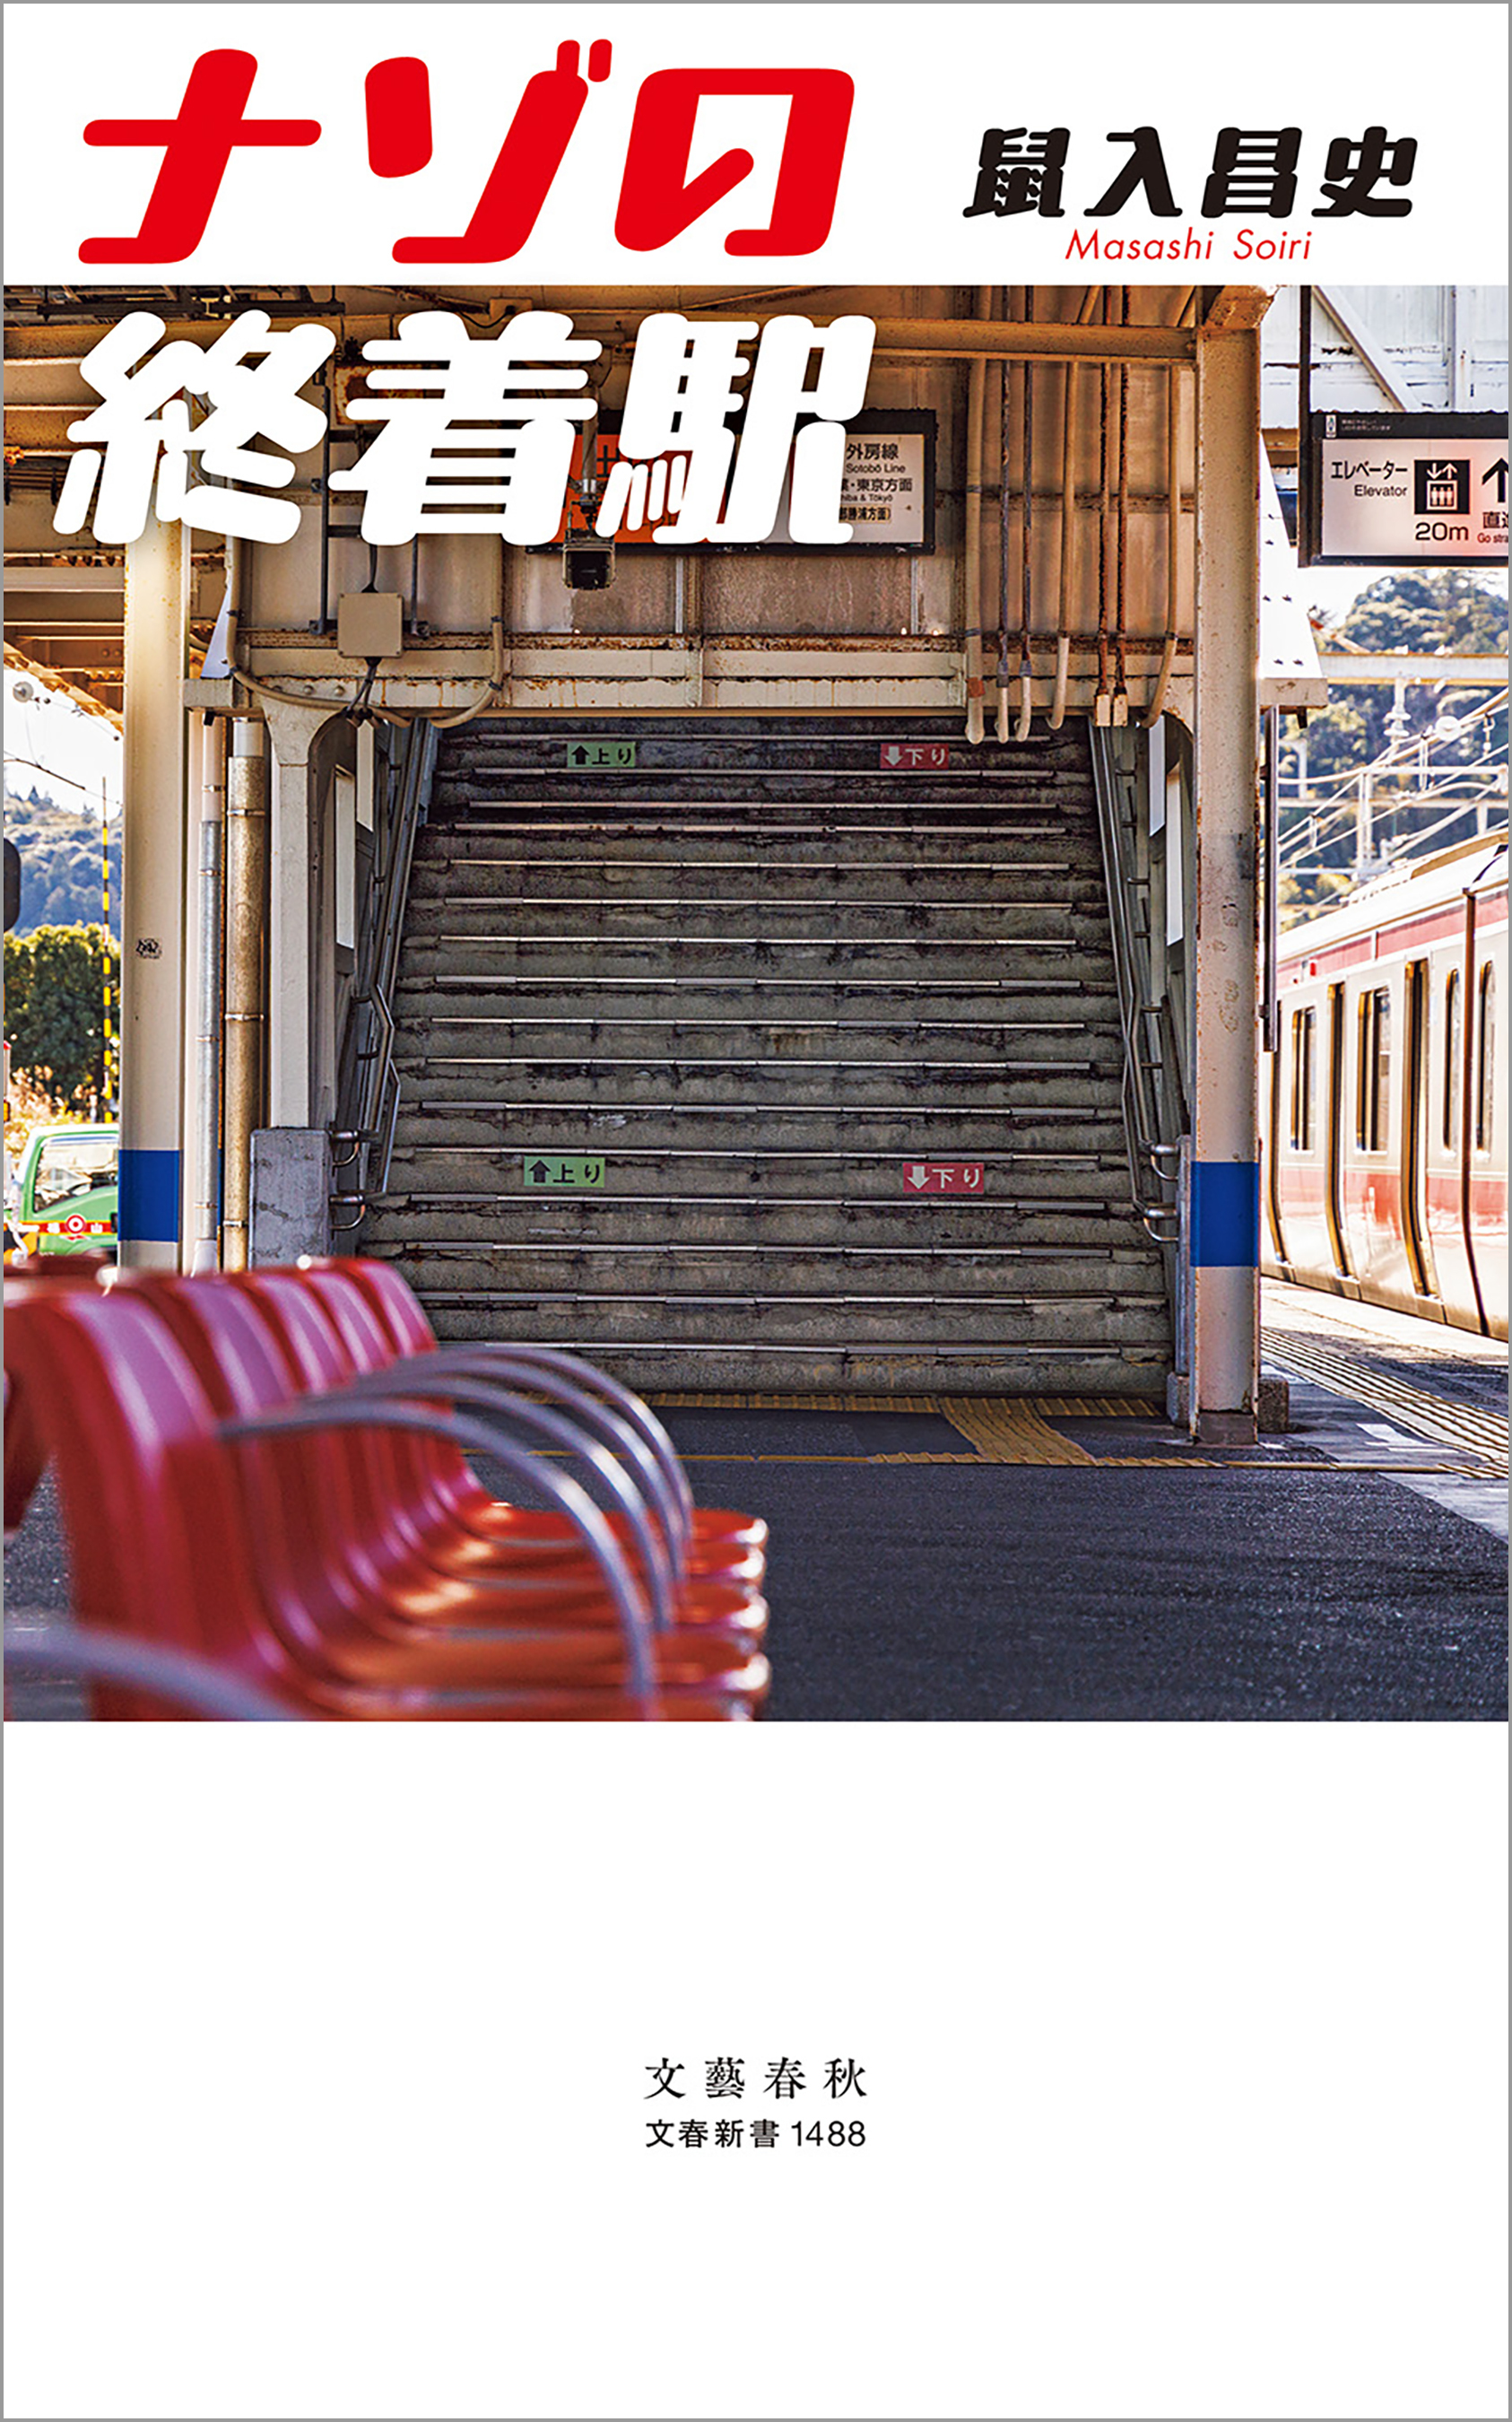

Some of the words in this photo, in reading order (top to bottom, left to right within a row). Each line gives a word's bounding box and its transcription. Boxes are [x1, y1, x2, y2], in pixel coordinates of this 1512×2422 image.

[847, 443, 899, 460] 外房線
[884, 463, 906, 474] Line
[1331, 460, 1408, 480] エレベーター
[1354, 484, 1408, 497] Elevator
[1415, 522, 1469, 542] 20m
[1477, 532, 1491, 544] Go
[592, 747, 631, 765] 上り
[905, 748, 945, 766] 下り
[552, 1163, 600, 1184] 上り
[932, 1168, 979, 1189] 下り
